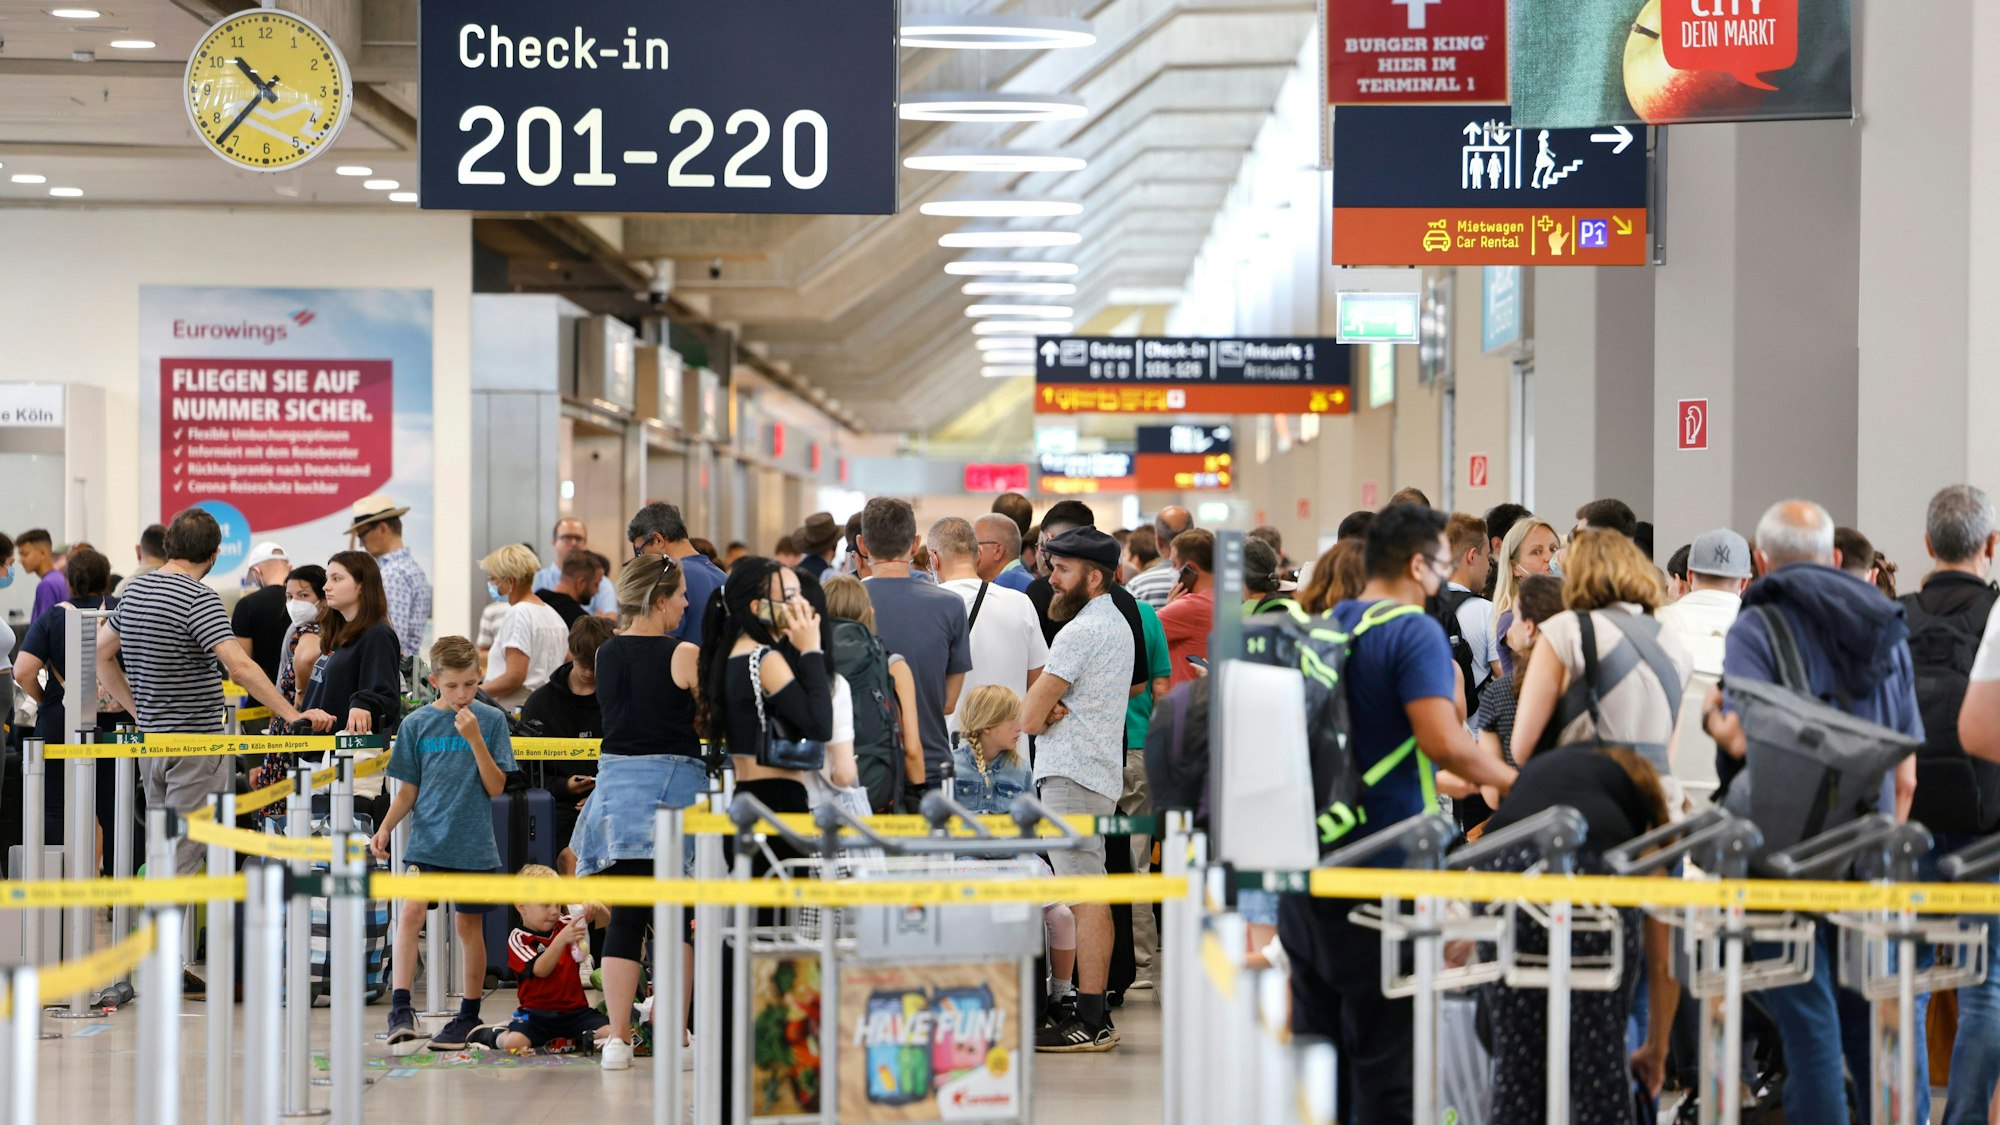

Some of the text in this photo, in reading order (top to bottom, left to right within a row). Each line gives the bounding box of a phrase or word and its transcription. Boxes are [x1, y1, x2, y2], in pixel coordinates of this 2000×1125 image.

[258, 27, 273, 39] 12
[1681, 18, 1776, 48] DEIN MARKT
[231, 36, 245, 48] 11
[290, 37, 297, 48] 1
[459, 23, 669, 70] Check-in
[1345, 37, 1428, 53] BURGER
[209, 56, 224, 68] 10
[310, 58, 318, 71] 2
[1377, 57, 1456, 72] HIER IM
[204, 84, 211, 96] 9
[320, 86, 327, 98] 3
[1357, 77, 1475, 93] TERMINAL 1
[213, 112, 221, 124] 8
[309, 112, 317, 125] 4
[232, 135, 240, 147] 7
[263, 142, 271, 154] 6
[292, 136, 300, 148] 5
[457, 105, 828, 190] 201-220
[1457, 220, 1524, 235] Mietwagen
[1456, 235, 1520, 249] Car Rental
[172, 320, 288, 345] Eurowings
[1145, 341, 1208, 359] Check-in
[172, 368, 361, 393] FLIEGEN SIE AUF
[16, 407, 53, 422] Köln
[172, 398, 373, 422] NUMMER SICHER.
[188, 427, 350, 444] Flexible Umbuchungsoptionen
[188, 444, 359, 459] Informiert mit dem Reiseberater
[276, 462, 303, 476] nach
[304, 463, 371, 477] Deutschland
[182, 745, 207, 754] Airport
[267, 742, 283, 750] Bonn
[284, 741, 308, 750] Airport
[543, 749, 567, 758] Airport
[853, 1008, 1006, 1047] HAVE FUN!
